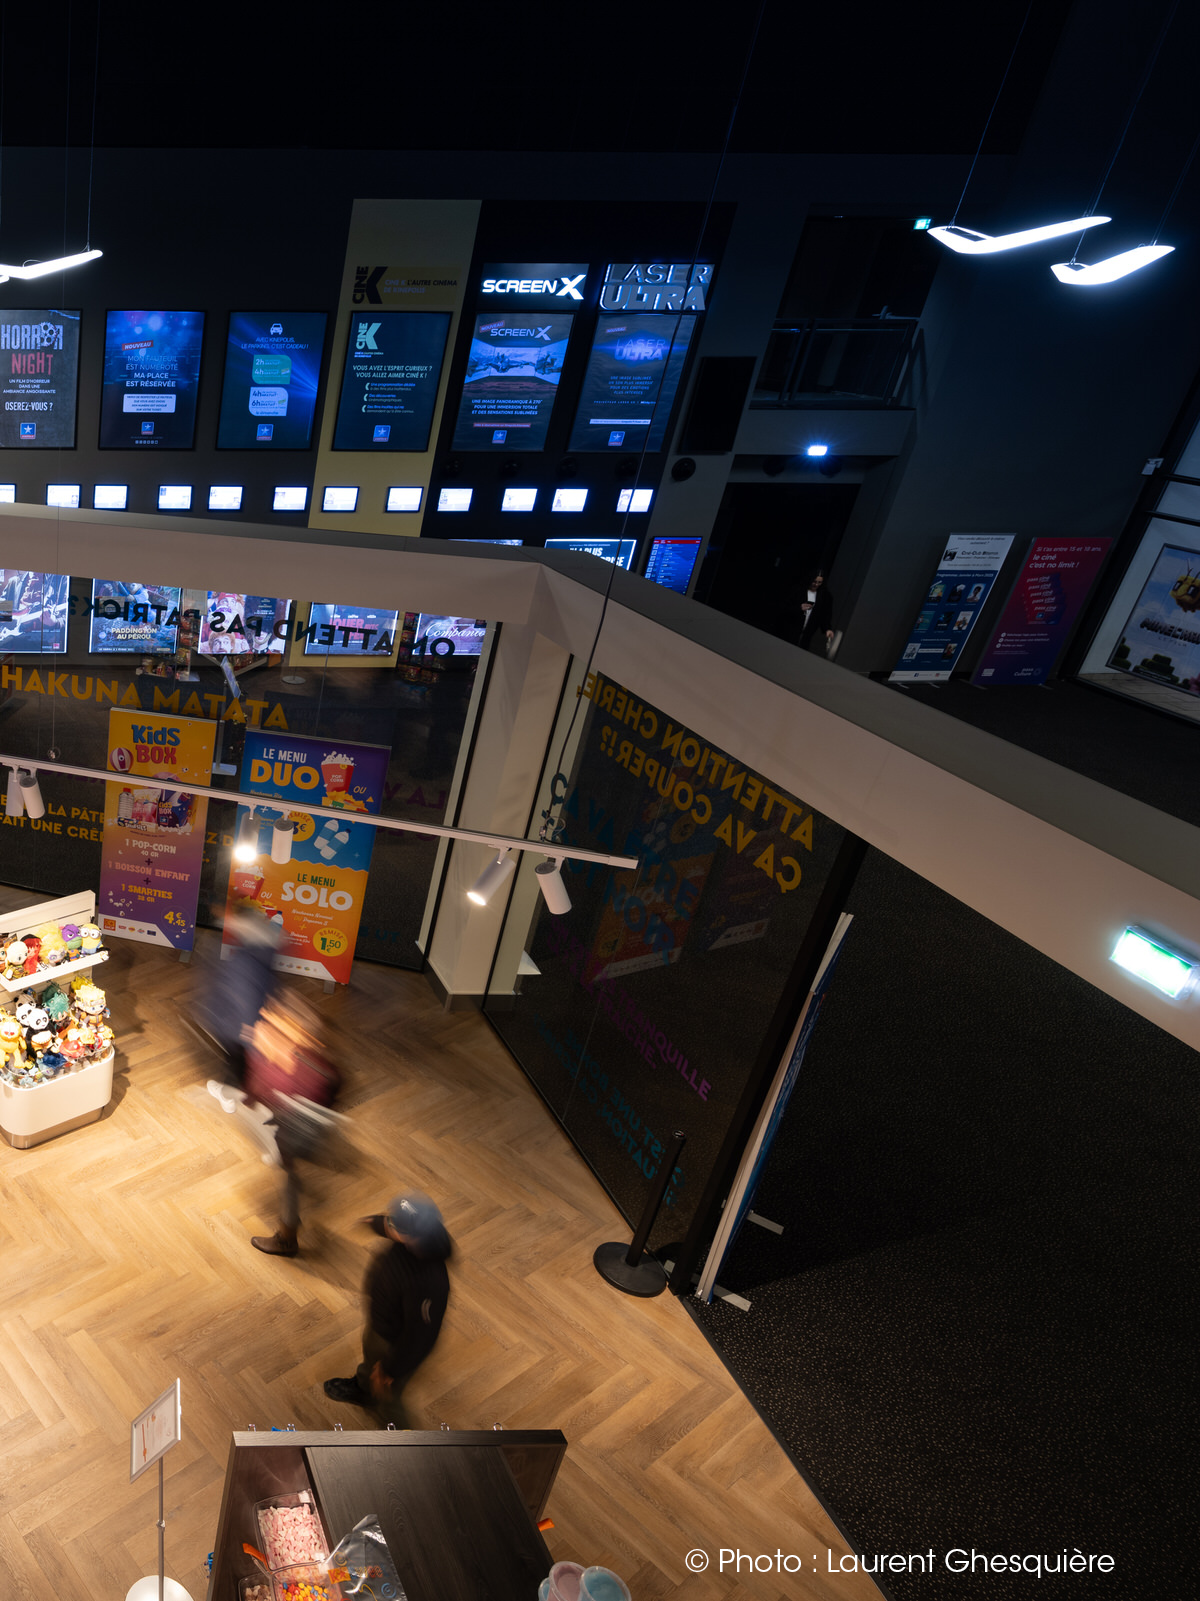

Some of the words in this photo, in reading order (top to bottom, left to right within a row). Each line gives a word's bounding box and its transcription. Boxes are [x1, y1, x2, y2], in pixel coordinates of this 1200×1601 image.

[604, 264, 712, 284] LASER
[482, 274, 586, 300] SCREENX
[600, 285, 705, 310] ULTRA
[124, 342, 152, 350] NOUVEAU
[615, 348, 663, 360] ULTRA
[11, 352, 53, 375] NIGHT
[140, 379, 176, 387] RÉSERVÉE
[5, 401, 48, 411] OSEREZ-VOUS
[128, 632, 151, 640] PÉROU
[1, 664, 141, 708] HAKUNA
[152, 685, 289, 730] MATATA
[135, 743, 178, 766] BOX
[263, 747, 275, 760] LE
[277, 749, 307, 765] MENU
[249, 758, 320, 790] DUO
[353, 785, 367, 795] OU
[47, 802, 68, 818] LA
[30, 817, 63, 836] UNE
[132, 839, 177, 855] POP-CORN
[150, 850, 159, 859] GR
[114, 861, 153, 877] BOISSON
[154, 868, 191, 883] ENFANT
[297, 872, 308, 883] LE
[309, 874, 336, 888] MENU
[127, 884, 173, 900] SMARTIES
[260, 891, 273, 900] OU
[280, 881, 353, 912] SOLO
[618, 986, 712, 1101] TRANQUILLE
